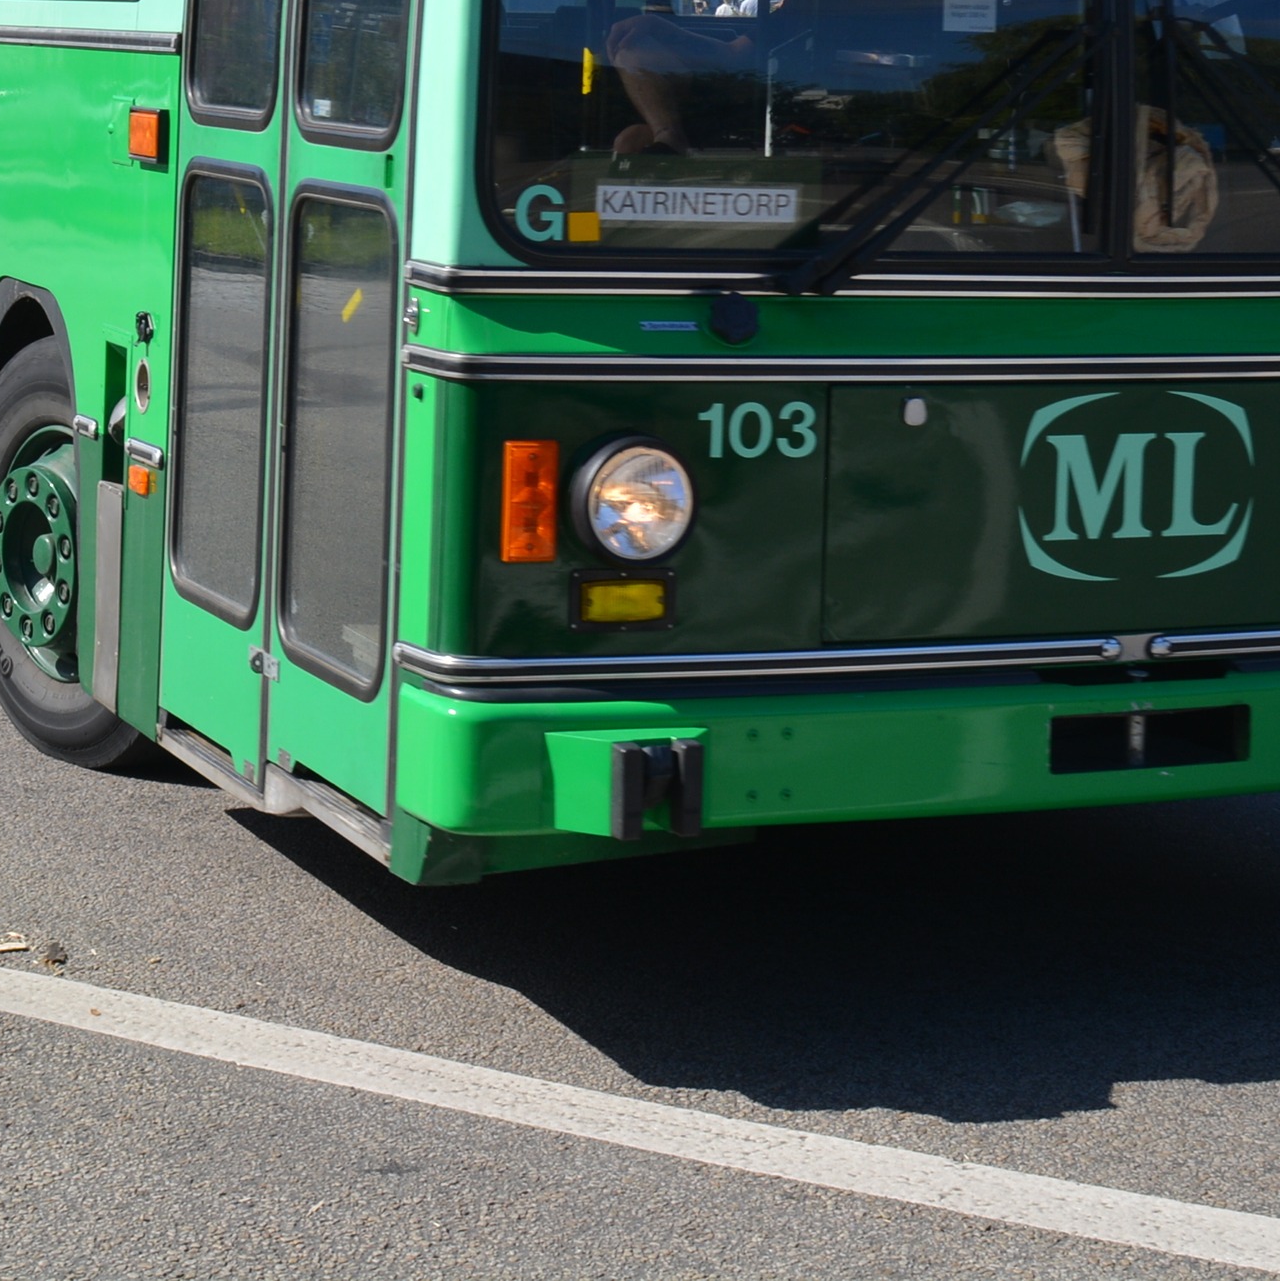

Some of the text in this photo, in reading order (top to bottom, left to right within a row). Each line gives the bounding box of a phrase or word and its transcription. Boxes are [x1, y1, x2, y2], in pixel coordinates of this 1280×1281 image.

[515, 184, 565, 242] G
[601, 190, 792, 217] KATRINETORP
[697, 401, 817, 459] 103
[1042, 431, 1238, 541] ML
